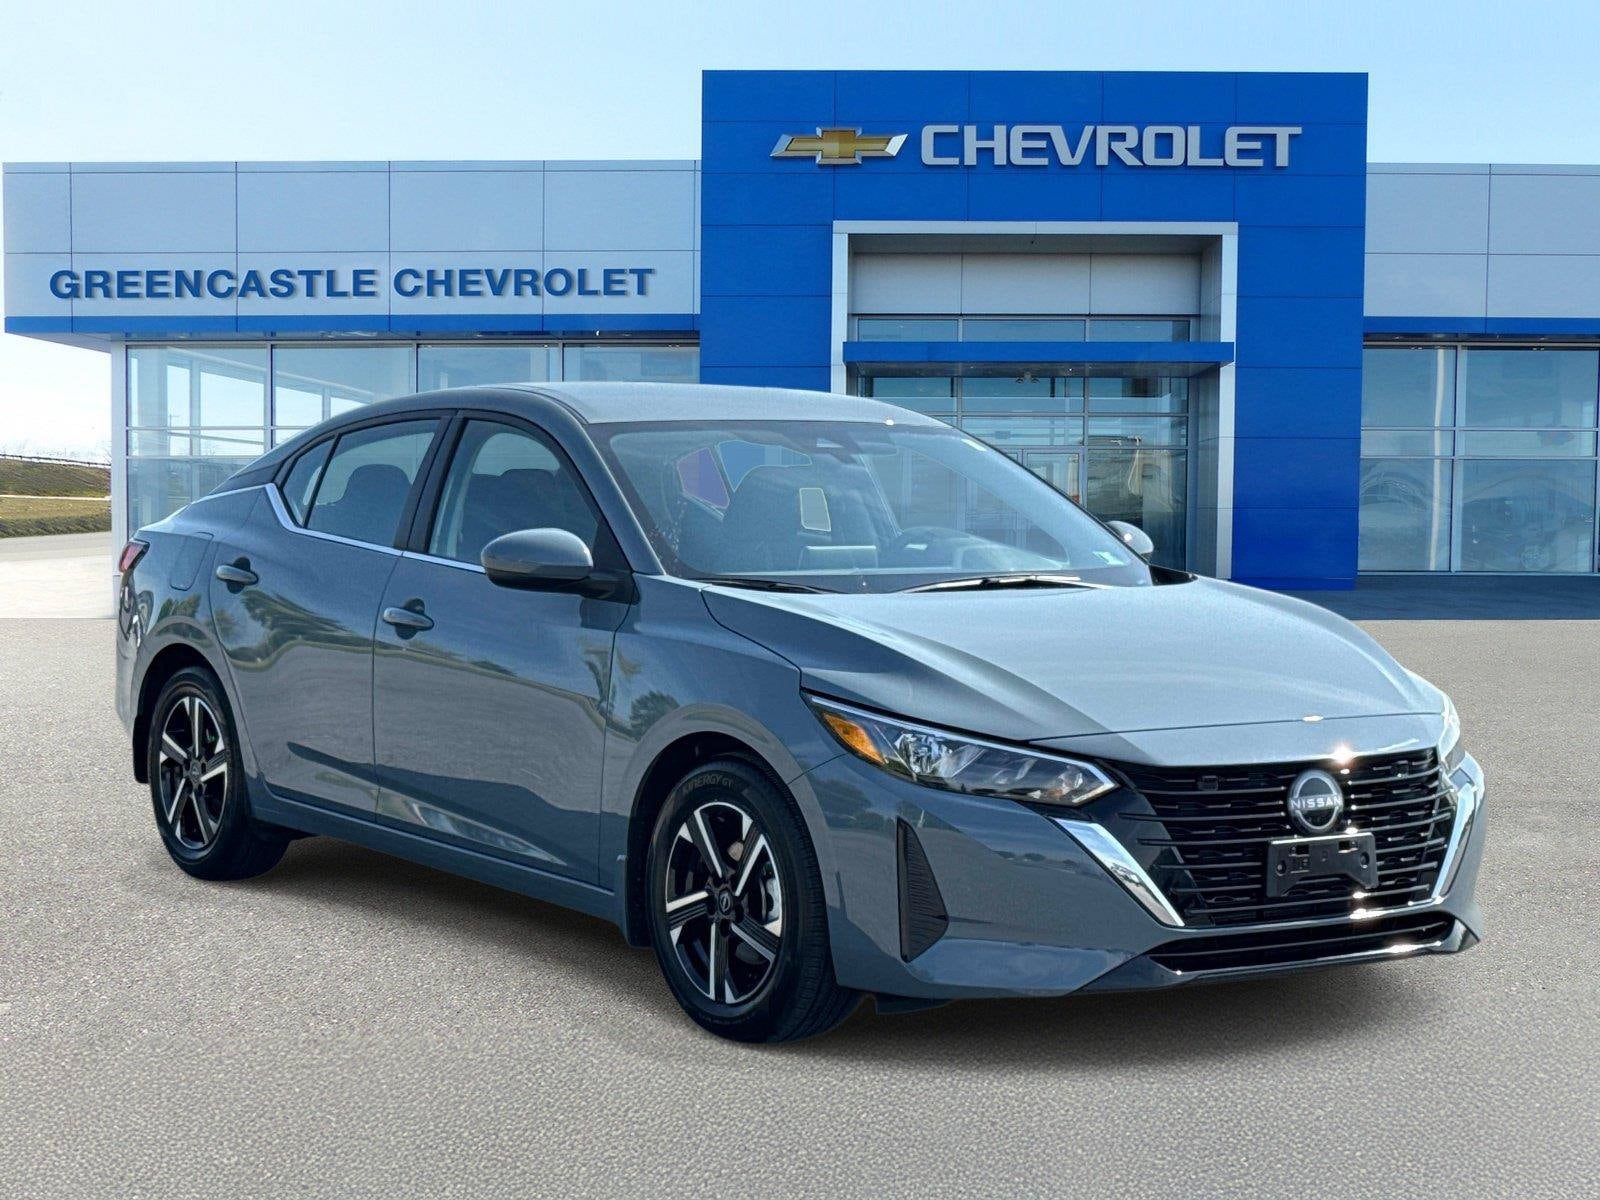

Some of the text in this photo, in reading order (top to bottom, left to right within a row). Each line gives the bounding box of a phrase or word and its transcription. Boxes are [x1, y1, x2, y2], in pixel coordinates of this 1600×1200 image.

[921, 125, 1302, 168] CHEVROLET
[50, 268, 655, 300] GREENCASTLE CHEVROLET
[1290, 796, 1341, 809] NISSAN
